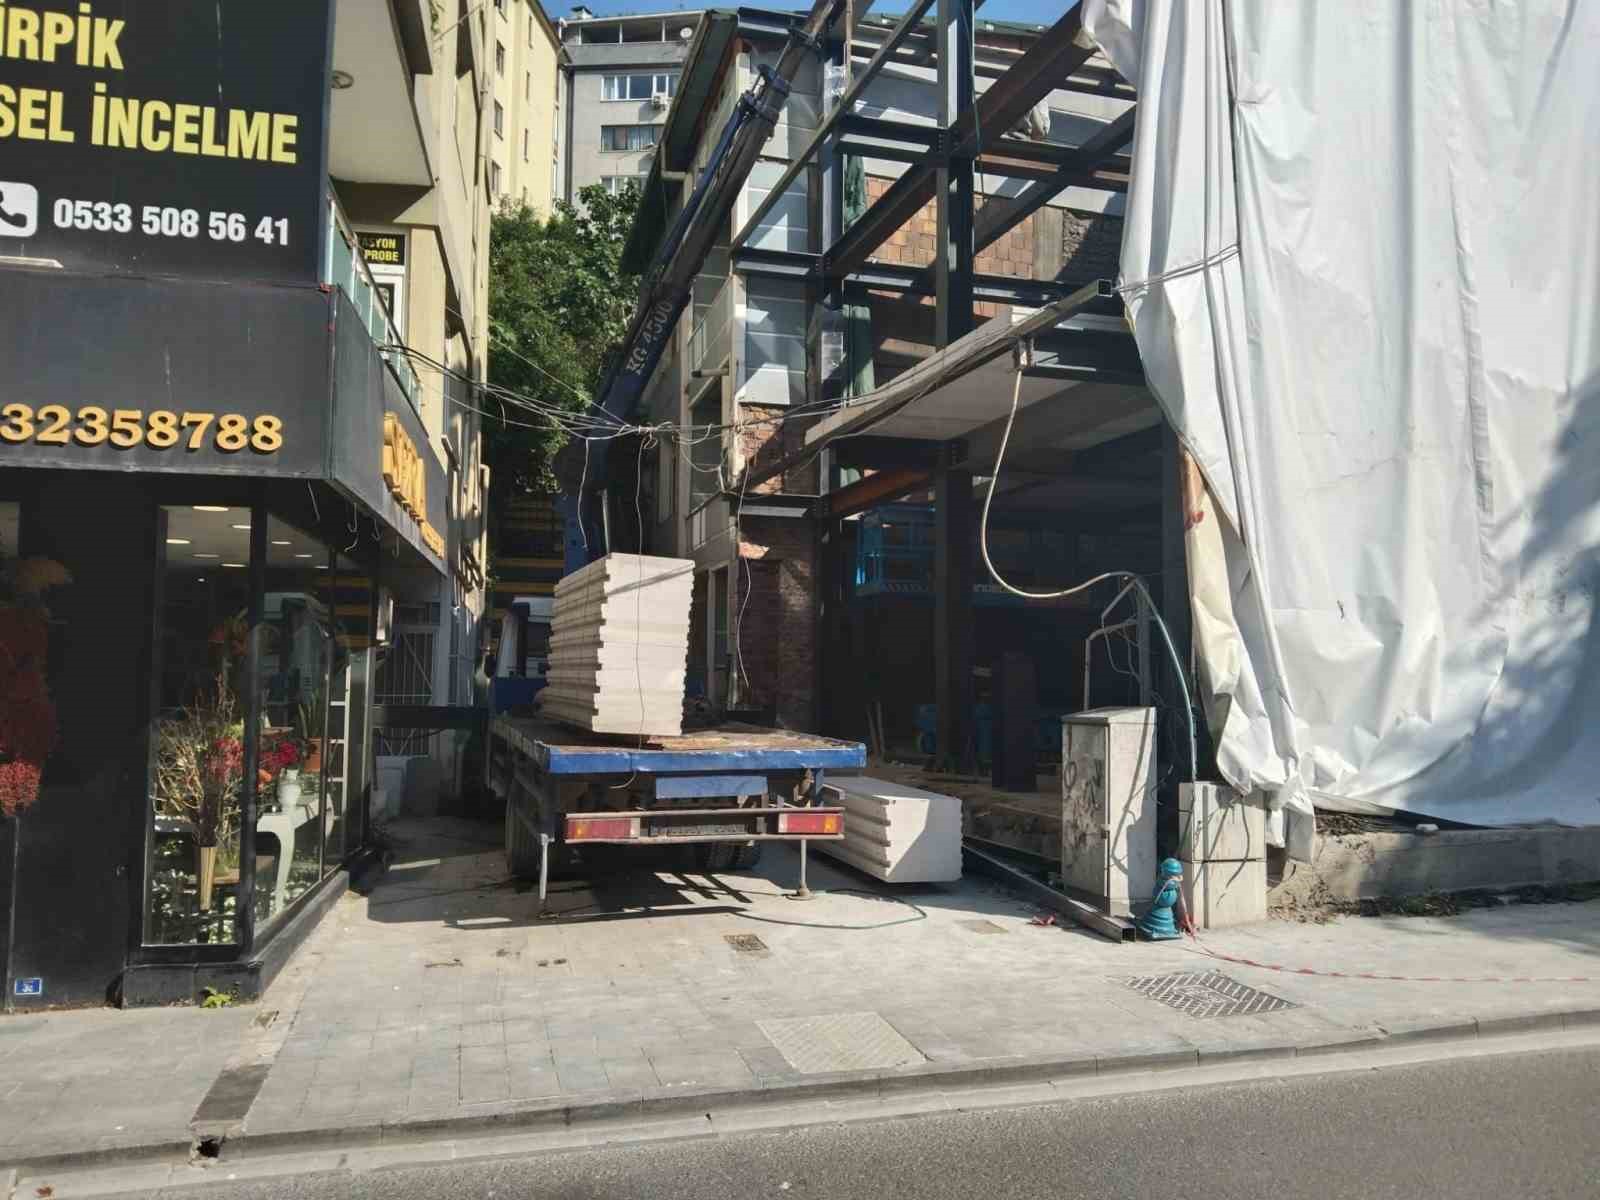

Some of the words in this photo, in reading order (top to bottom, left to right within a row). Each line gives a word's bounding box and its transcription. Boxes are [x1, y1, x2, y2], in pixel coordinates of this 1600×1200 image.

[91, 82, 298, 164] İNCELME
[53, 198, 132, 233] 0533
[141, 205, 199, 238] 508
[208, 211, 246, 242] 56
[254, 216, 288, 246] 41
[364, 249, 400, 262] PROBE
[0, 403, 283, 451] 32358788
